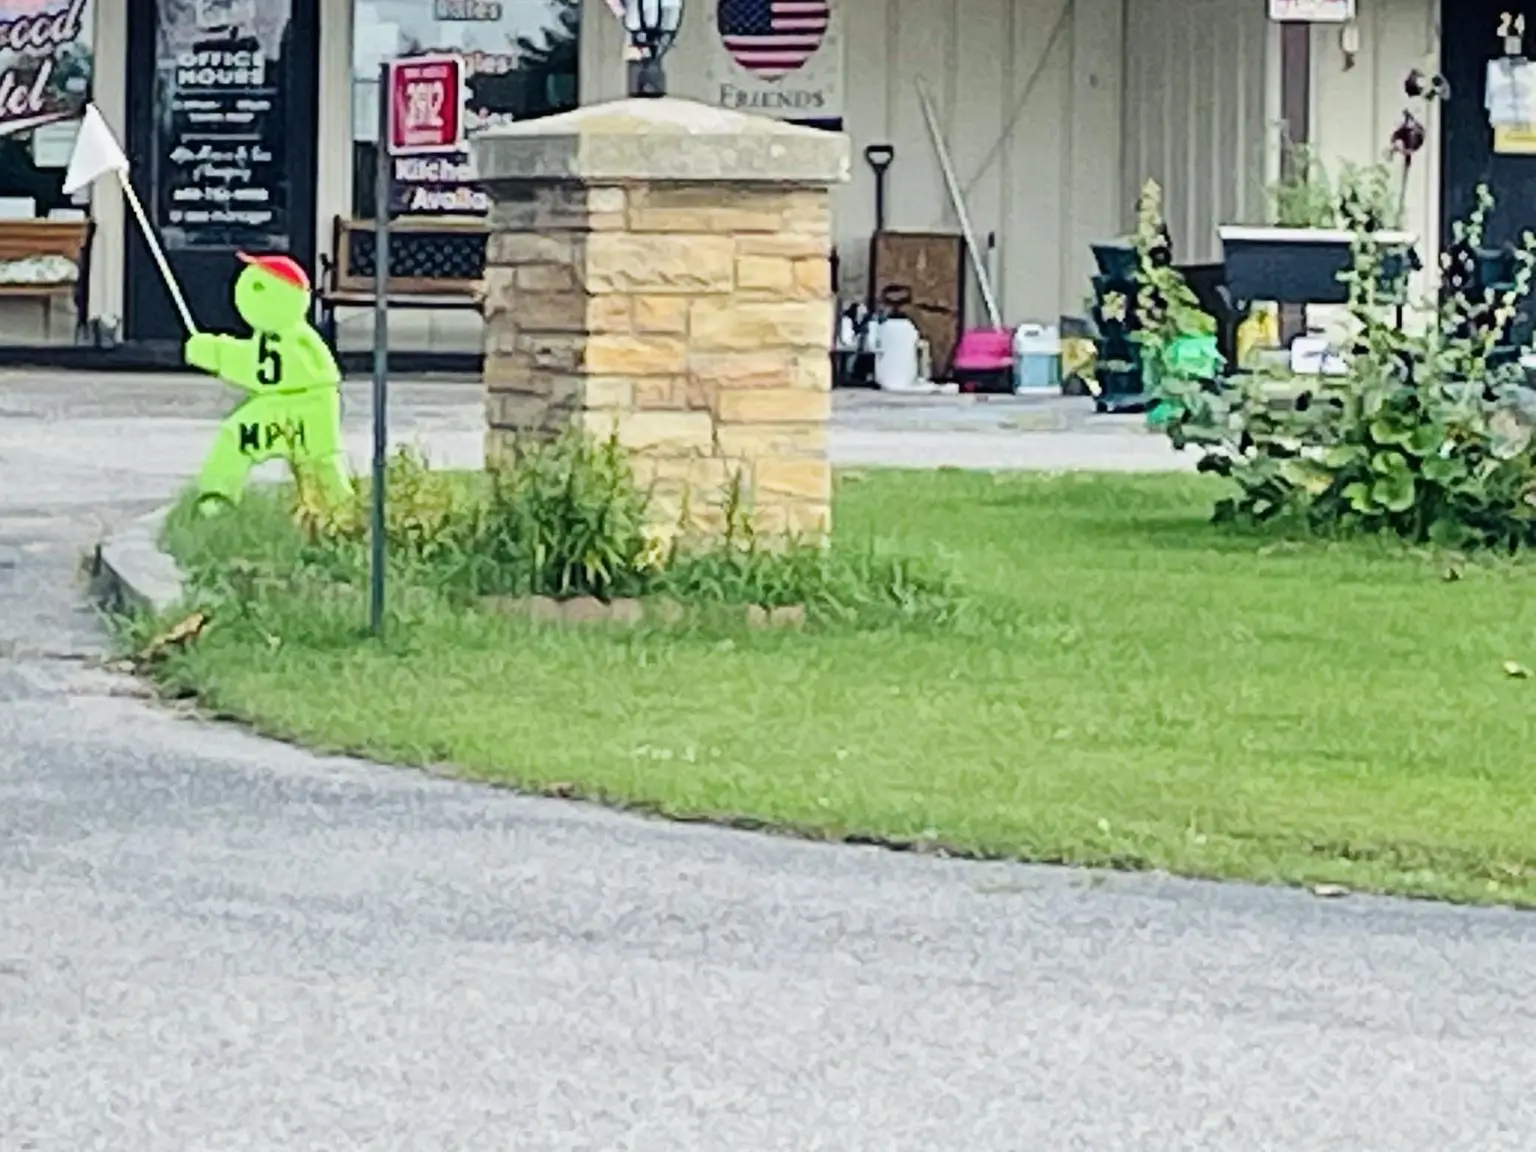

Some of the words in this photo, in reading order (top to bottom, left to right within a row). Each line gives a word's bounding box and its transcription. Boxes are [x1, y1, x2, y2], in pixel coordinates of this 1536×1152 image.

[177, 51, 266, 67] OFFICE
[719, 83, 825, 109] FRIENDS
[256, 331, 282, 385] 5
[238, 419, 306, 451] MPH
